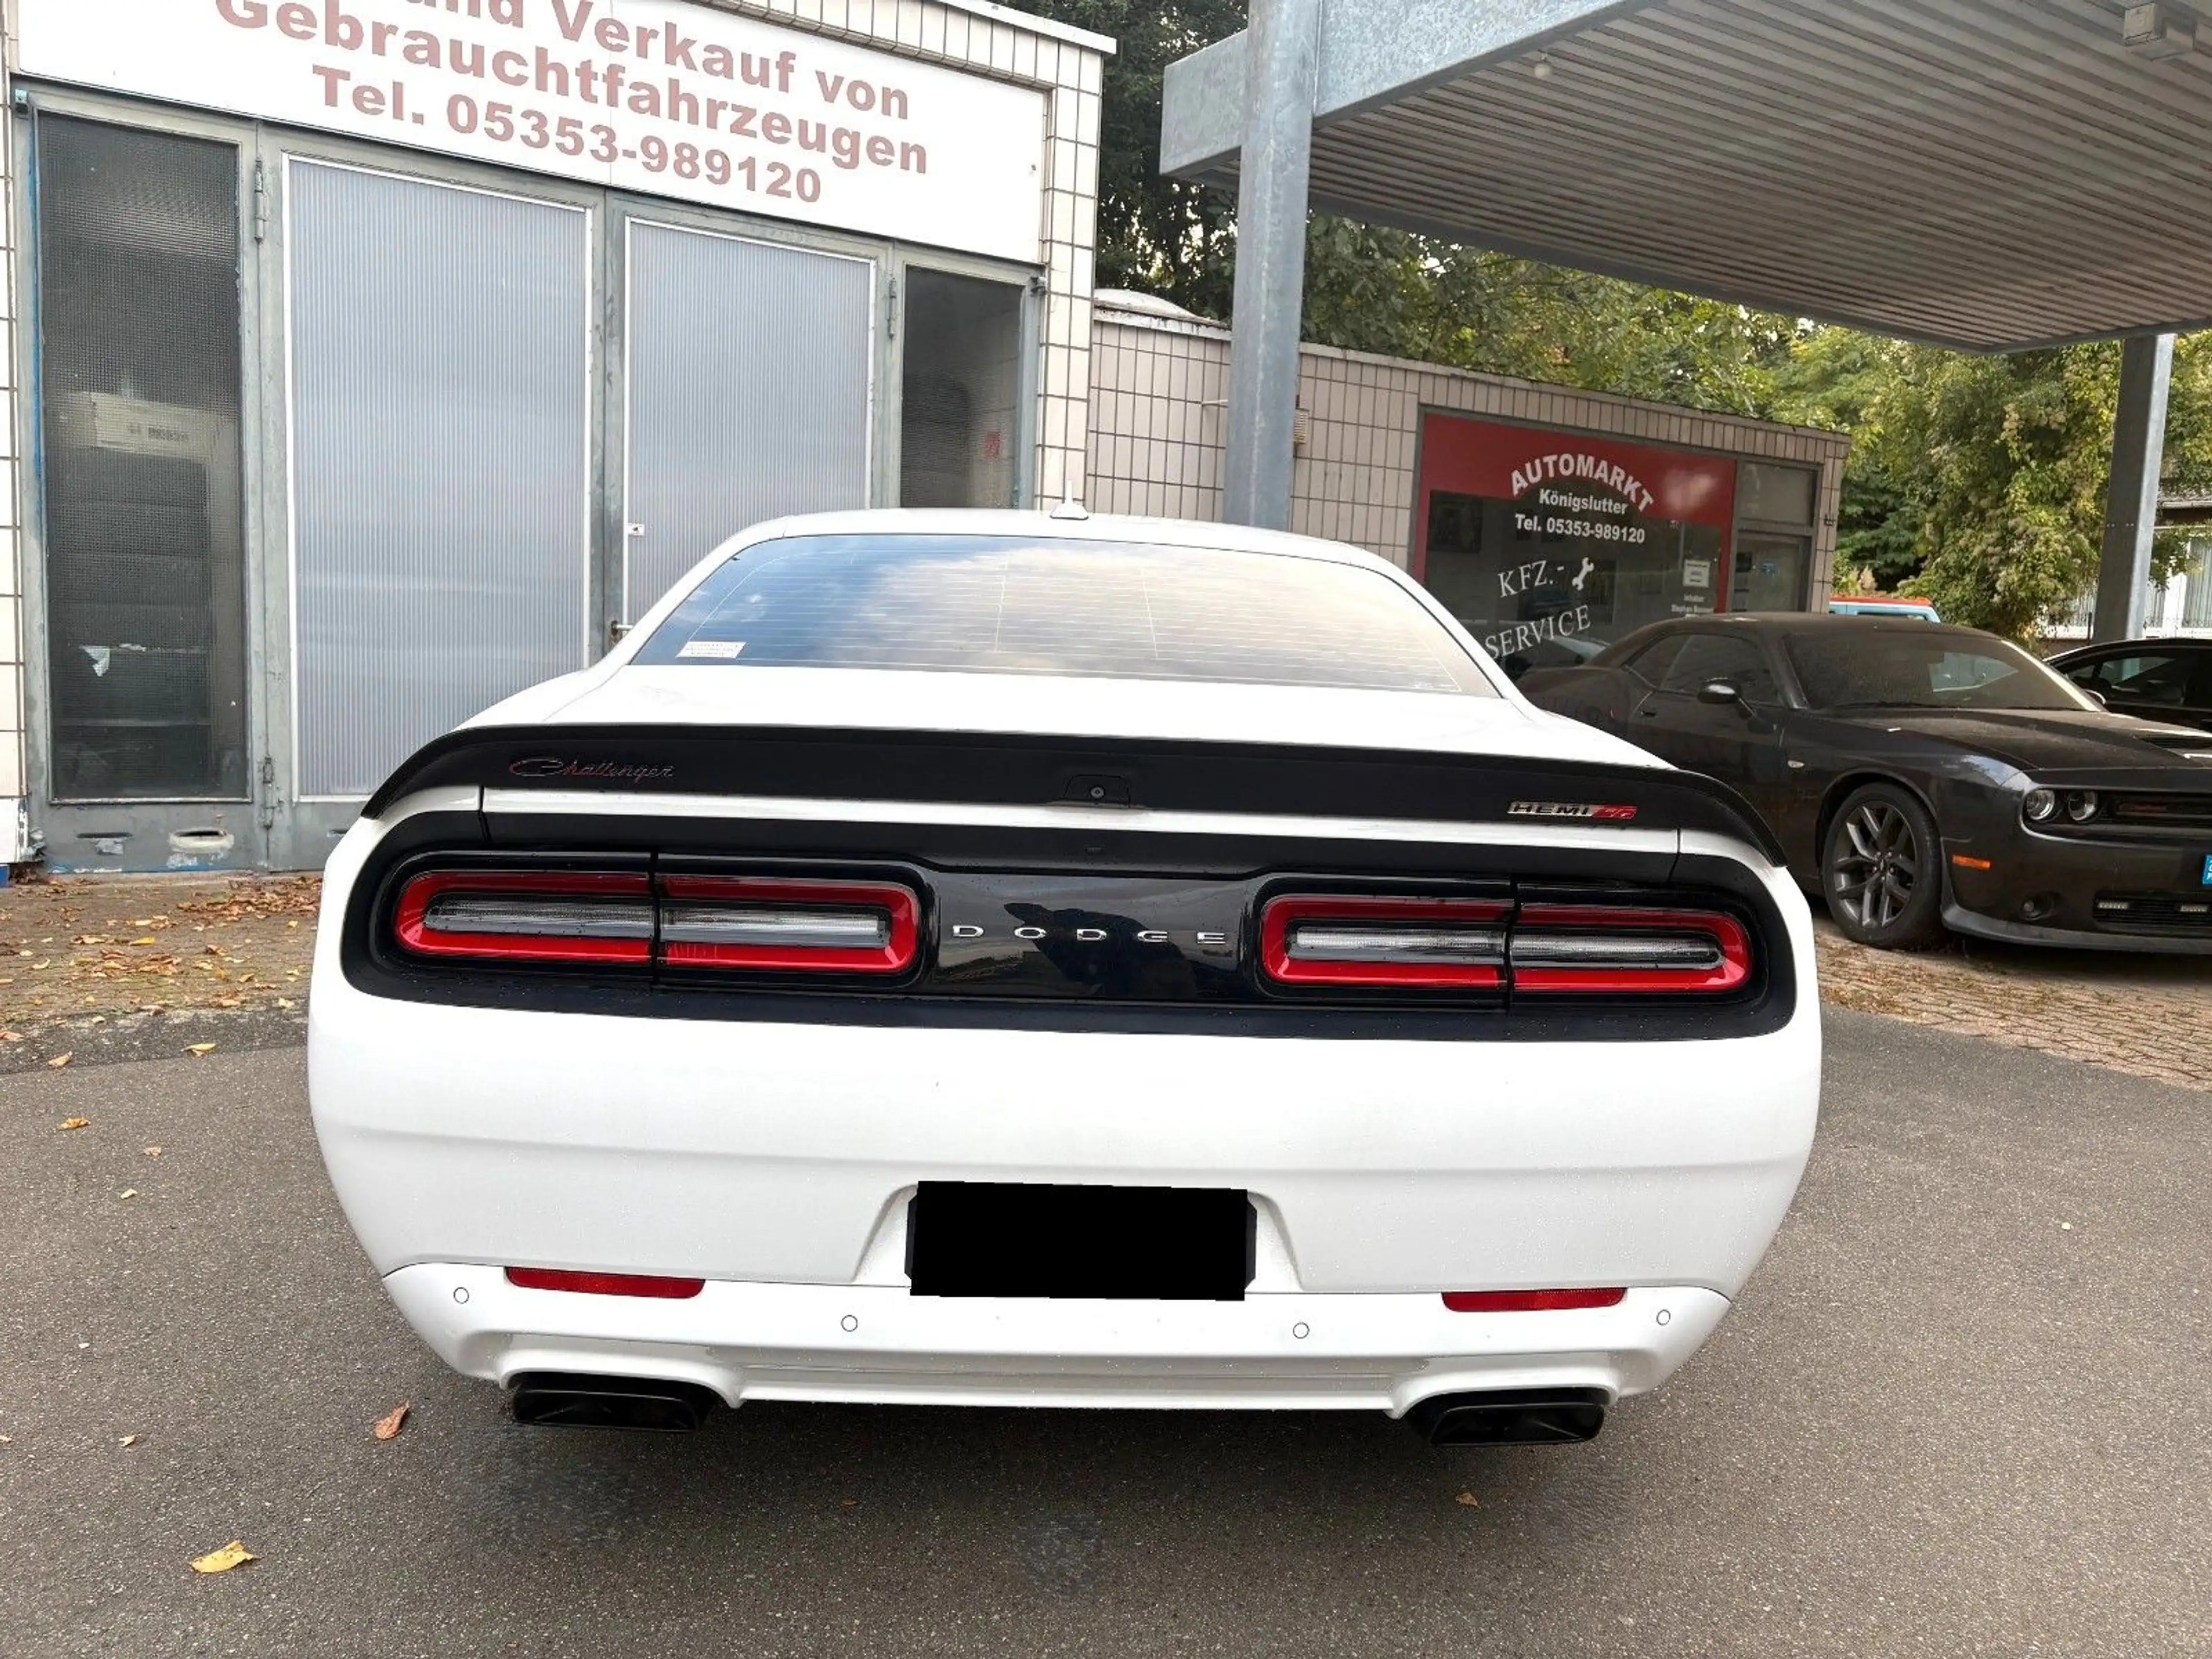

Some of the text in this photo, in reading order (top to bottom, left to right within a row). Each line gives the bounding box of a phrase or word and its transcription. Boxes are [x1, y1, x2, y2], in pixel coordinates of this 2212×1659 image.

[551, 0, 908, 120] Verkauf von
[215, 0, 926, 175] Gebrauchtfahrzeugen
[312, 64, 820, 203] Tel. 05353-989120
[1511, 453, 1654, 512] AUTOMARKT
[1539, 488, 1628, 515] Königslutter
[1516, 513, 1645, 544] Tel. 05353-989120
[1484, 605, 1591, 660] SERVICE
[509, 756, 675, 783] Challenger
[1509, 802, 1590, 816] HEMI
[952, 924, 1226, 944] DODGE
